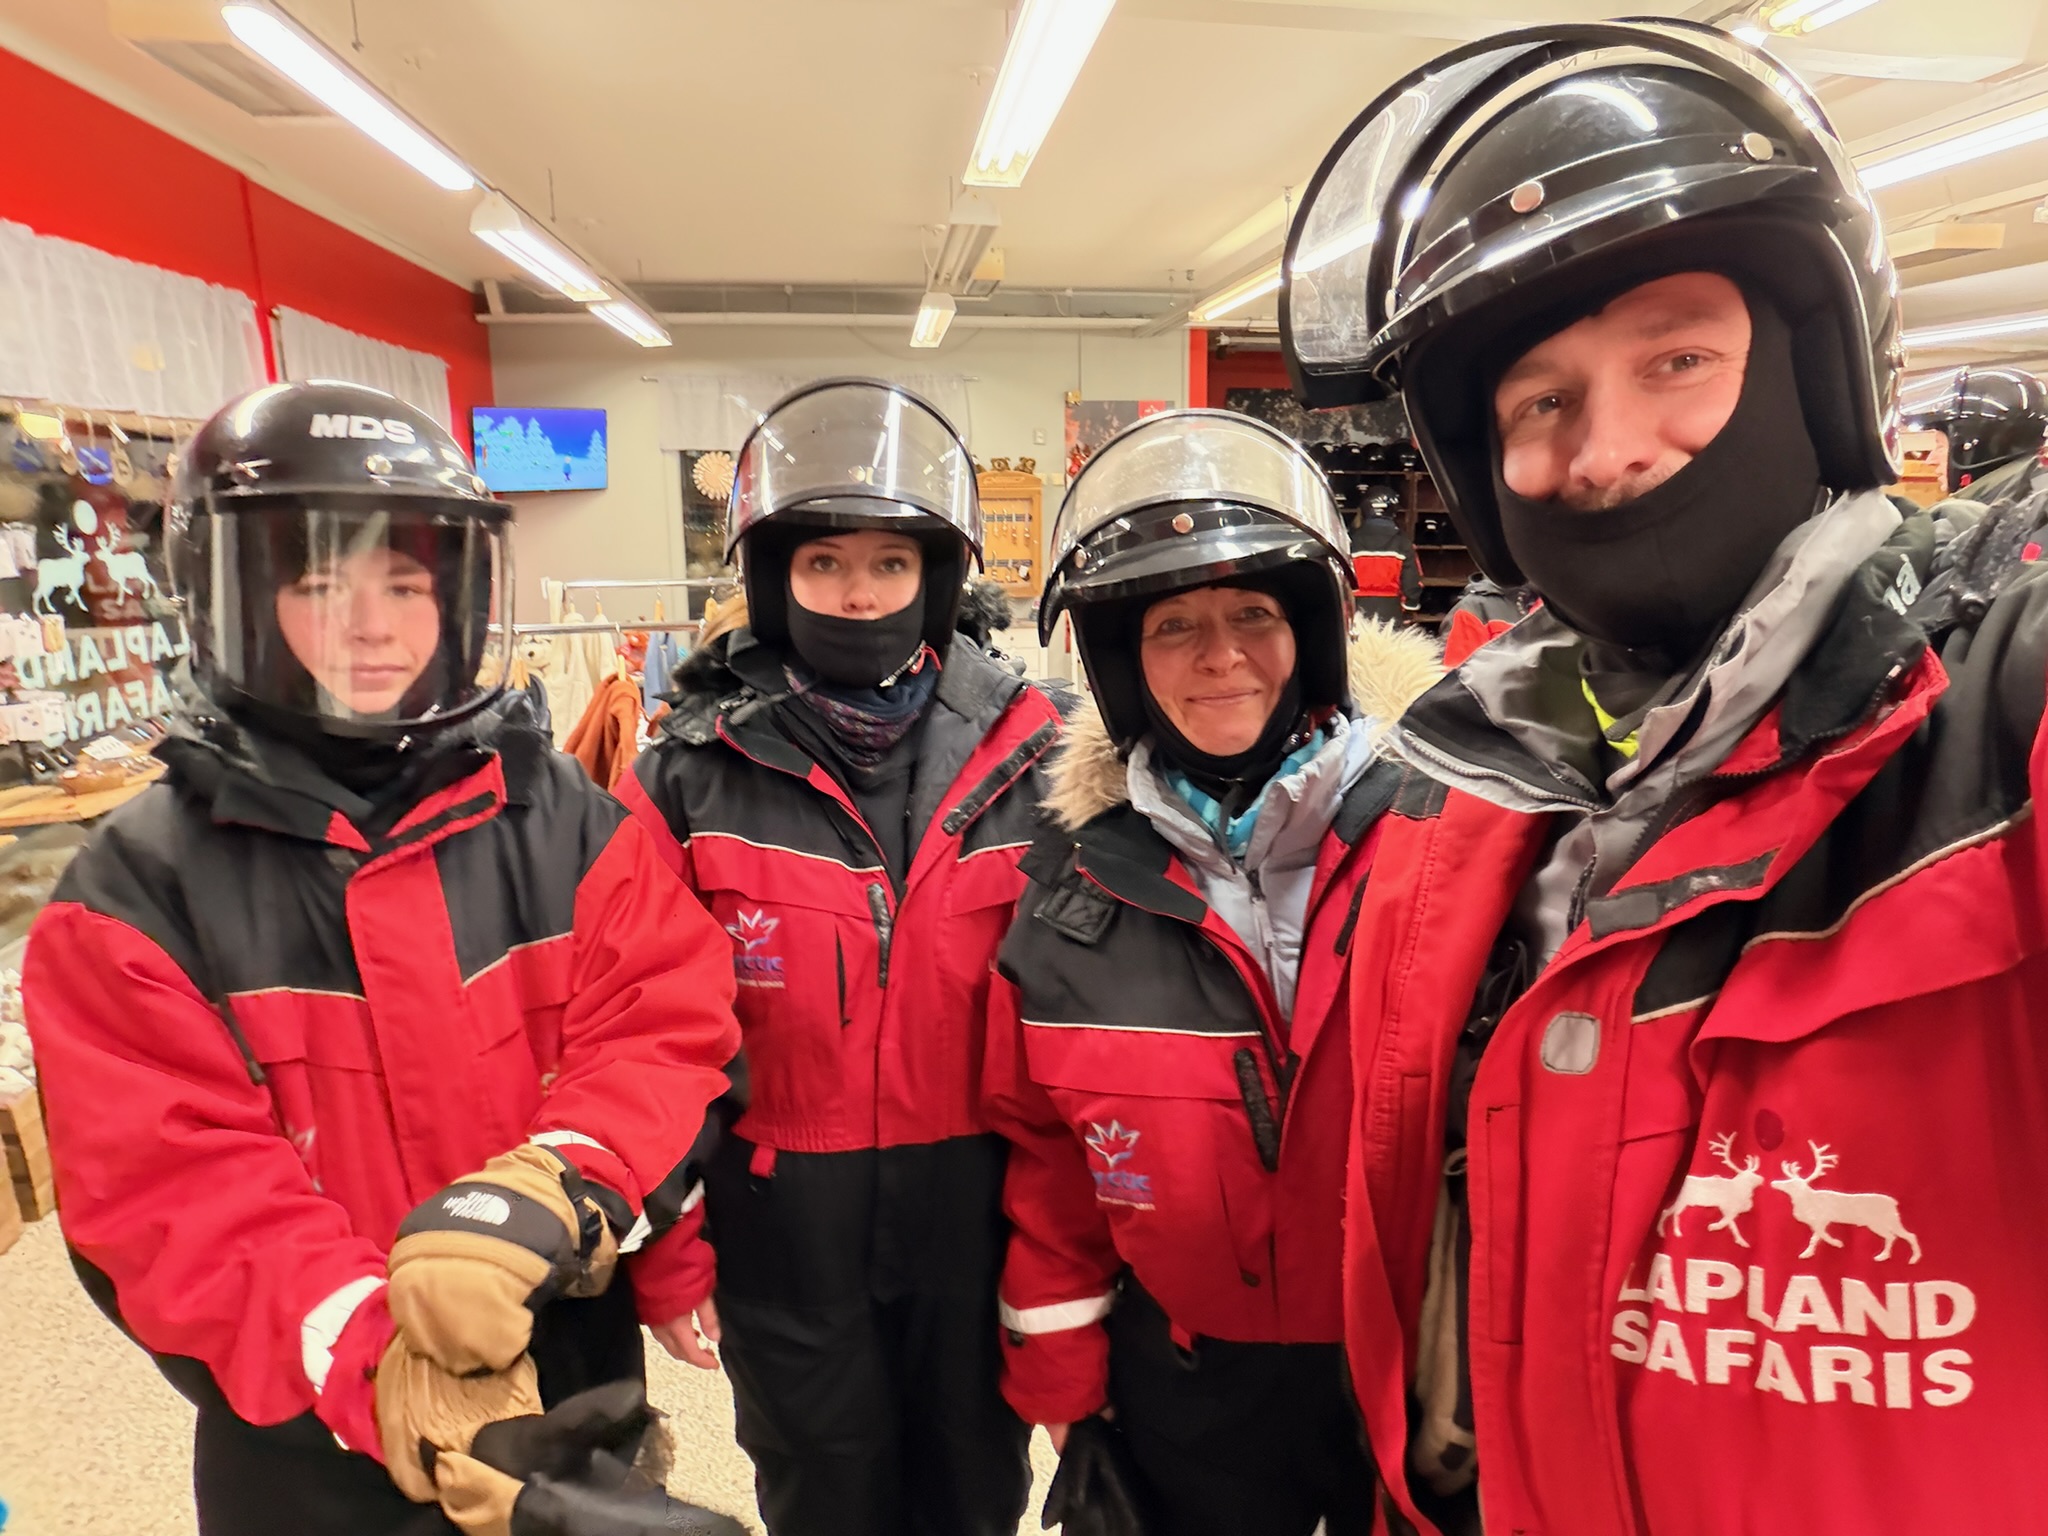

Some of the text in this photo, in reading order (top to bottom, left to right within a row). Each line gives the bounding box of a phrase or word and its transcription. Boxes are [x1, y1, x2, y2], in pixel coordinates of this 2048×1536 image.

[308, 413, 417, 445] MDS
[1617, 1252, 1977, 1341] LAPLAND
[1609, 1309, 1975, 1410] SAFARIS
